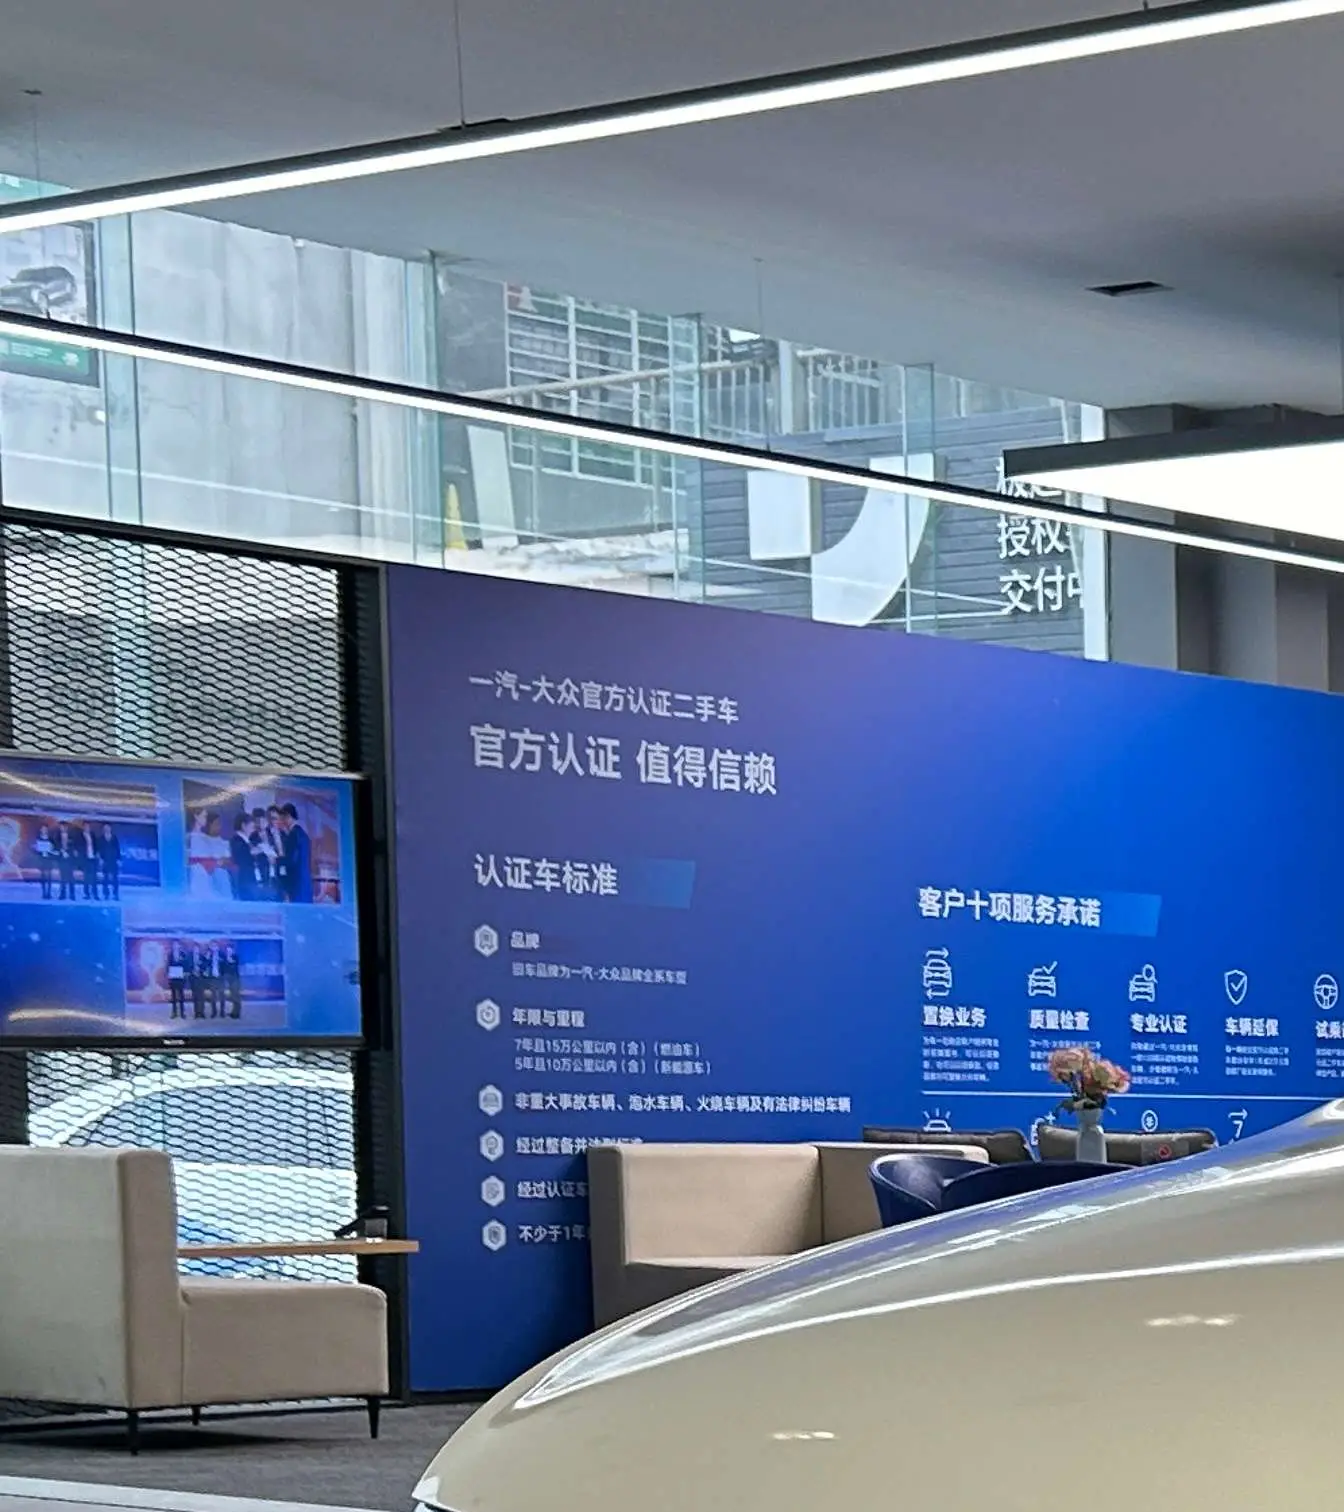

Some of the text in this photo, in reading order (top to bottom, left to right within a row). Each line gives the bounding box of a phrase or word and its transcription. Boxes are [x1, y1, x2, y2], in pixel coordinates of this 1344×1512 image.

[469, 670, 739, 725] 一汽-大众官方认证二手车
[470, 723, 777, 795] 官方认证 值得信赖
[474, 853, 619, 896] 认证车标准
[918, 886, 1101, 928] 客户十项服务承诺
[510, 931, 540, 949] 品牌
[512, 1007, 585, 1028] 年限与里程
[923, 1005, 987, 1028] 置换业务
[1130, 1013, 1187, 1034] 专业认证
[1225, 1017, 1279, 1037] 车辆延保
